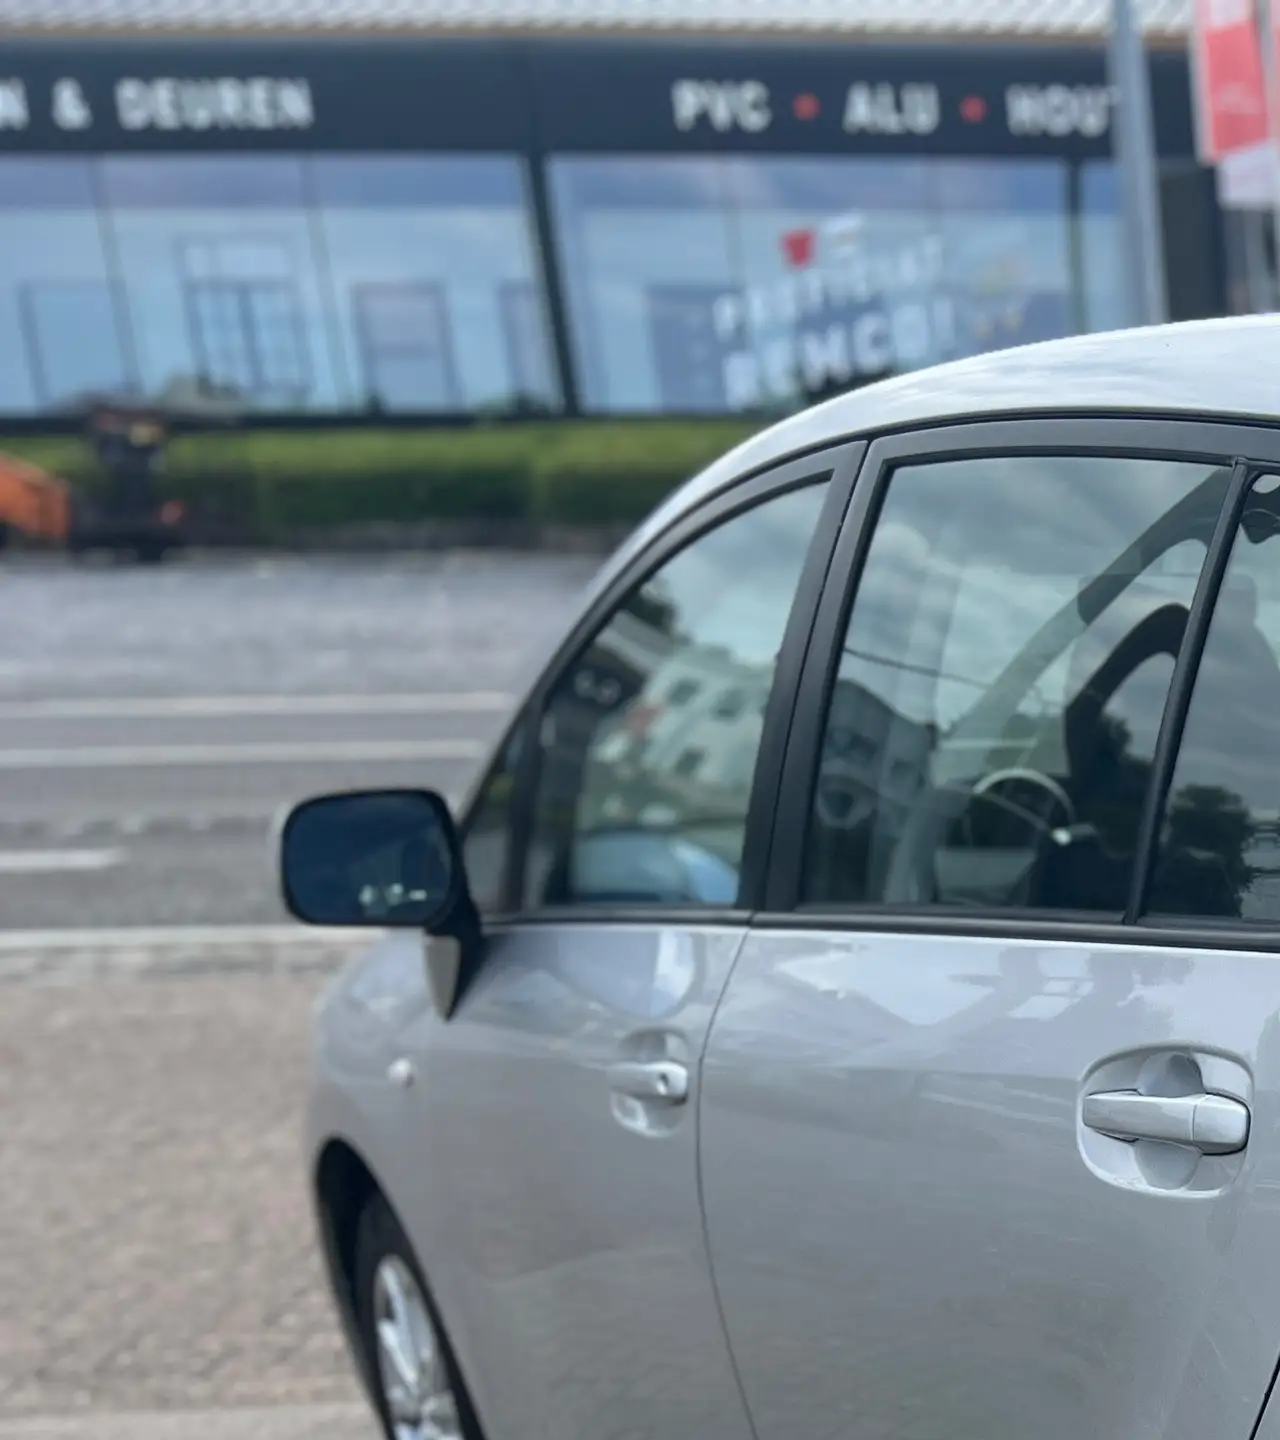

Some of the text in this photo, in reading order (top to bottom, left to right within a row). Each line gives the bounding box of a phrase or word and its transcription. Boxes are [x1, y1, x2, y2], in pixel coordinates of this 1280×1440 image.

[53, 77, 93, 130] &
[114, 77, 315, 130] DEUREN
[671, 79, 772, 133] PVC
[843, 81, 940, 135] ALU
